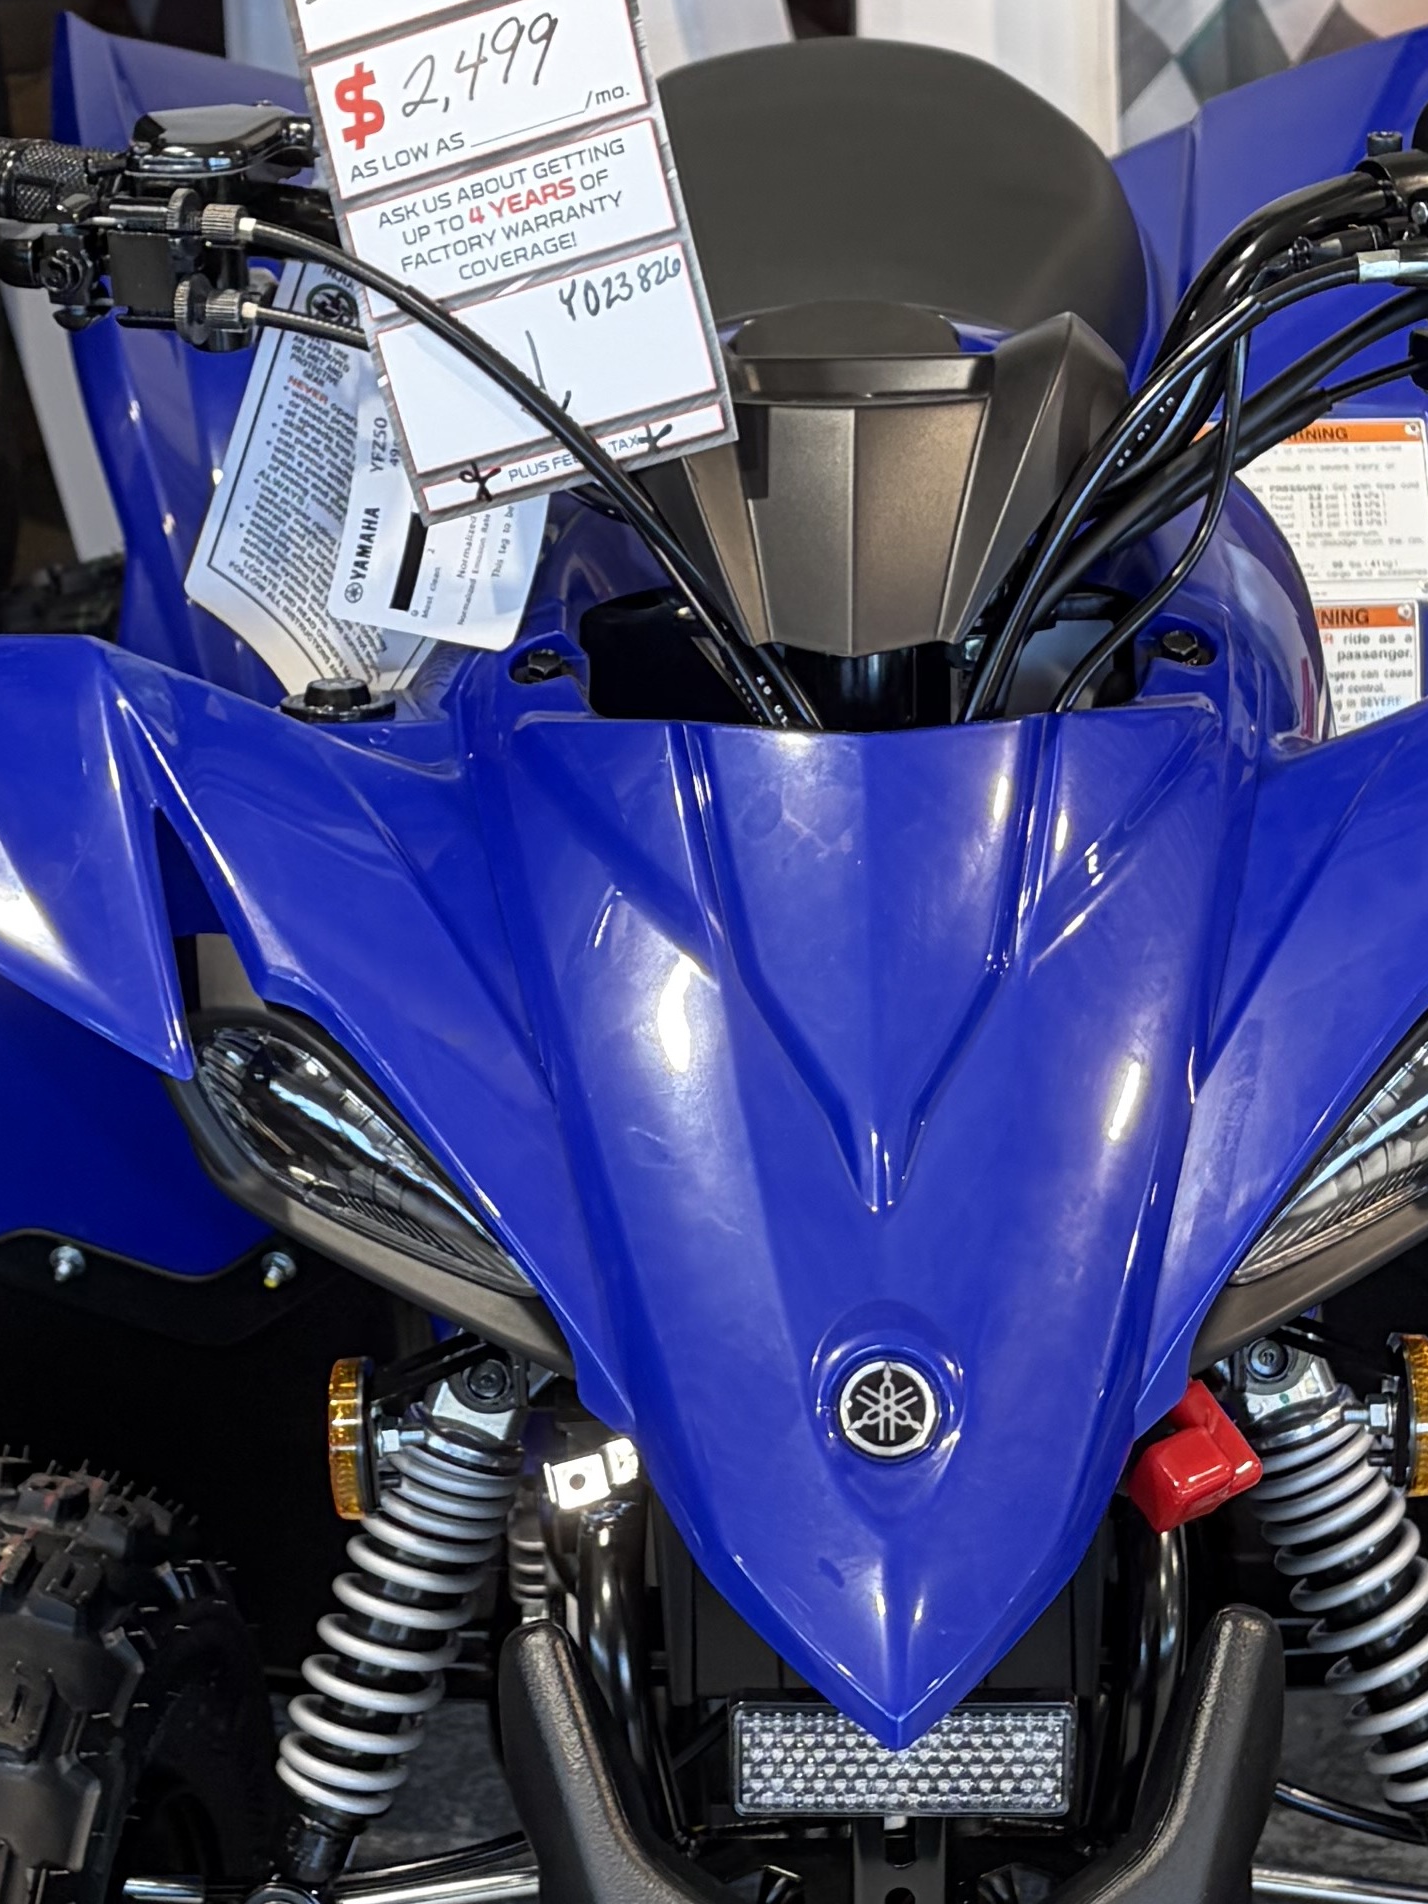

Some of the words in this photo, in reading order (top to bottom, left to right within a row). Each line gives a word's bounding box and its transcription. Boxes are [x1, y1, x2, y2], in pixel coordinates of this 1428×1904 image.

[334, 62, 385, 150] $
[401, 12, 559, 118] 2,499
[350, 158, 379, 182] AS
[382, 143, 430, 171] LOW
[436, 132, 465, 156] AS
[378, 200, 421, 229] ASK
[422, 192, 452, 213] US
[456, 167, 527, 203] ABOUT
[532, 137, 626, 180] GETTING
[401, 224, 431, 246] UP
[437, 214, 465, 234] TO
[468, 208, 486, 224] 4
[488, 176, 577, 219] YEARS
[579, 169, 610, 191] OF
[400, 229, 496, 273] FACTORY
[500, 190, 623, 241] WARRANTY
[458, 231, 578, 281] COVERAGE!
[289, 353, 339, 386] PROTECTIVE
[291, 344, 324, 365] HELMET
[326, 364, 343, 378] AND
[287, 375, 328, 404] NEVER
[369, 417, 387, 471] YFZ50
[268, 463, 279, 472] of
[269, 454, 310, 482] balance
[309, 482, 329, 498] and
[507, 459, 550, 482] PLUS
[245, 528, 272, 548] avoid
[250, 510, 278, 530] avoid
[279, 497, 312, 521] proper
[311, 521, 337, 545] riding
[286, 525, 306, 540] and
[350, 506, 381, 580] YAMAHA
[501, 522, 510, 533] to
[241, 538, 279, 565] exhaust
[279, 566, 310, 594] system
[455, 515, 477, 578] Normalized
[490, 558, 504, 577] This
[497, 538, 510, 554] tag
[239, 546, 265, 565] parts
[264, 565, 283, 580] can
[281, 580, 307, 604] cause
[243, 559, 278, 590] LOCATE
[278, 589, 297, 607] AND
[295, 606, 317, 629] READ
[429, 566, 440, 592] clean
[228, 560, 266, 592] FOLLOW
[265, 591, 282, 607] ALL
[281, 605, 330, 664] INSTRUCTIONS
[456, 577, 477, 625] Normalized
[1320, 607, 1370, 625] NING
[1343, 633, 1371, 645] ride
[1379, 634, 1395, 644] as
[1404, 634, 1413, 644] a
